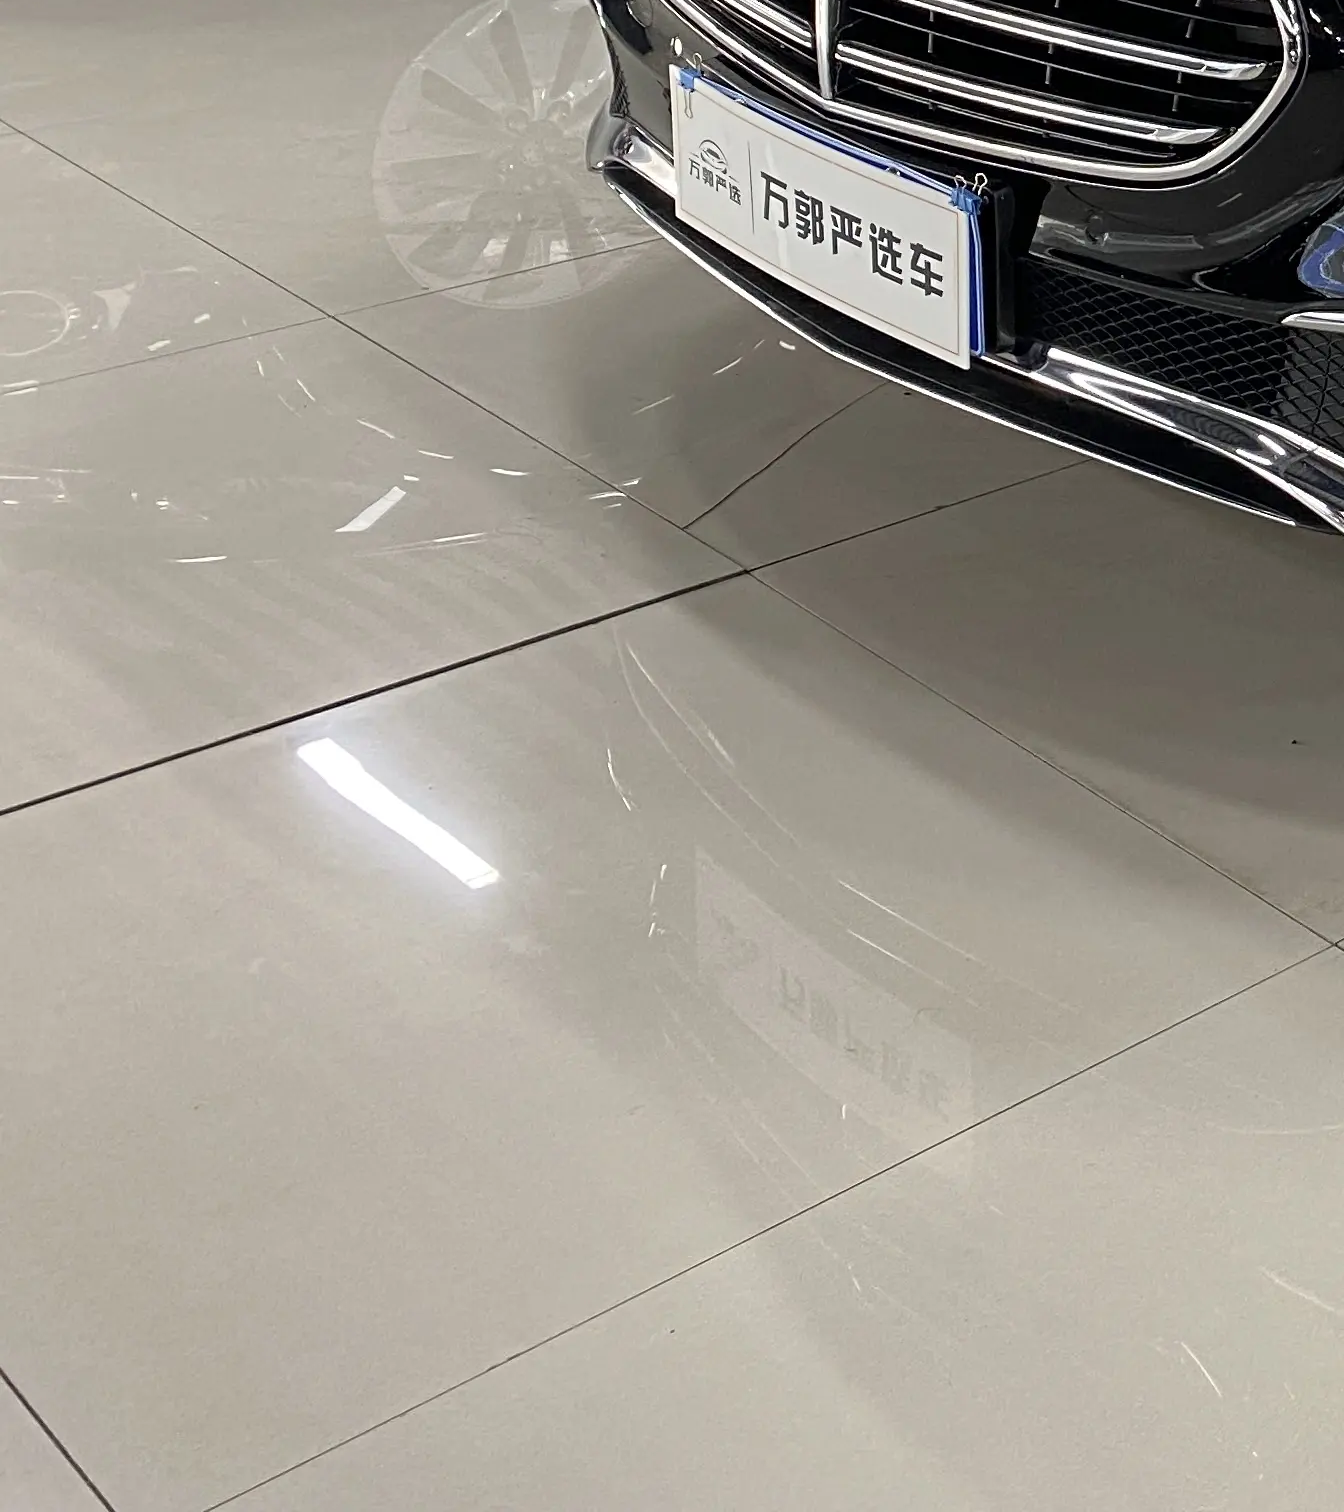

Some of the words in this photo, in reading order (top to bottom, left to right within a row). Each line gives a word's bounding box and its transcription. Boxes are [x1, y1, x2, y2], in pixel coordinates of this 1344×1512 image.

[688, 156, 742, 207] 万郭严选
[760, 170, 944, 298] 万郭严选车
